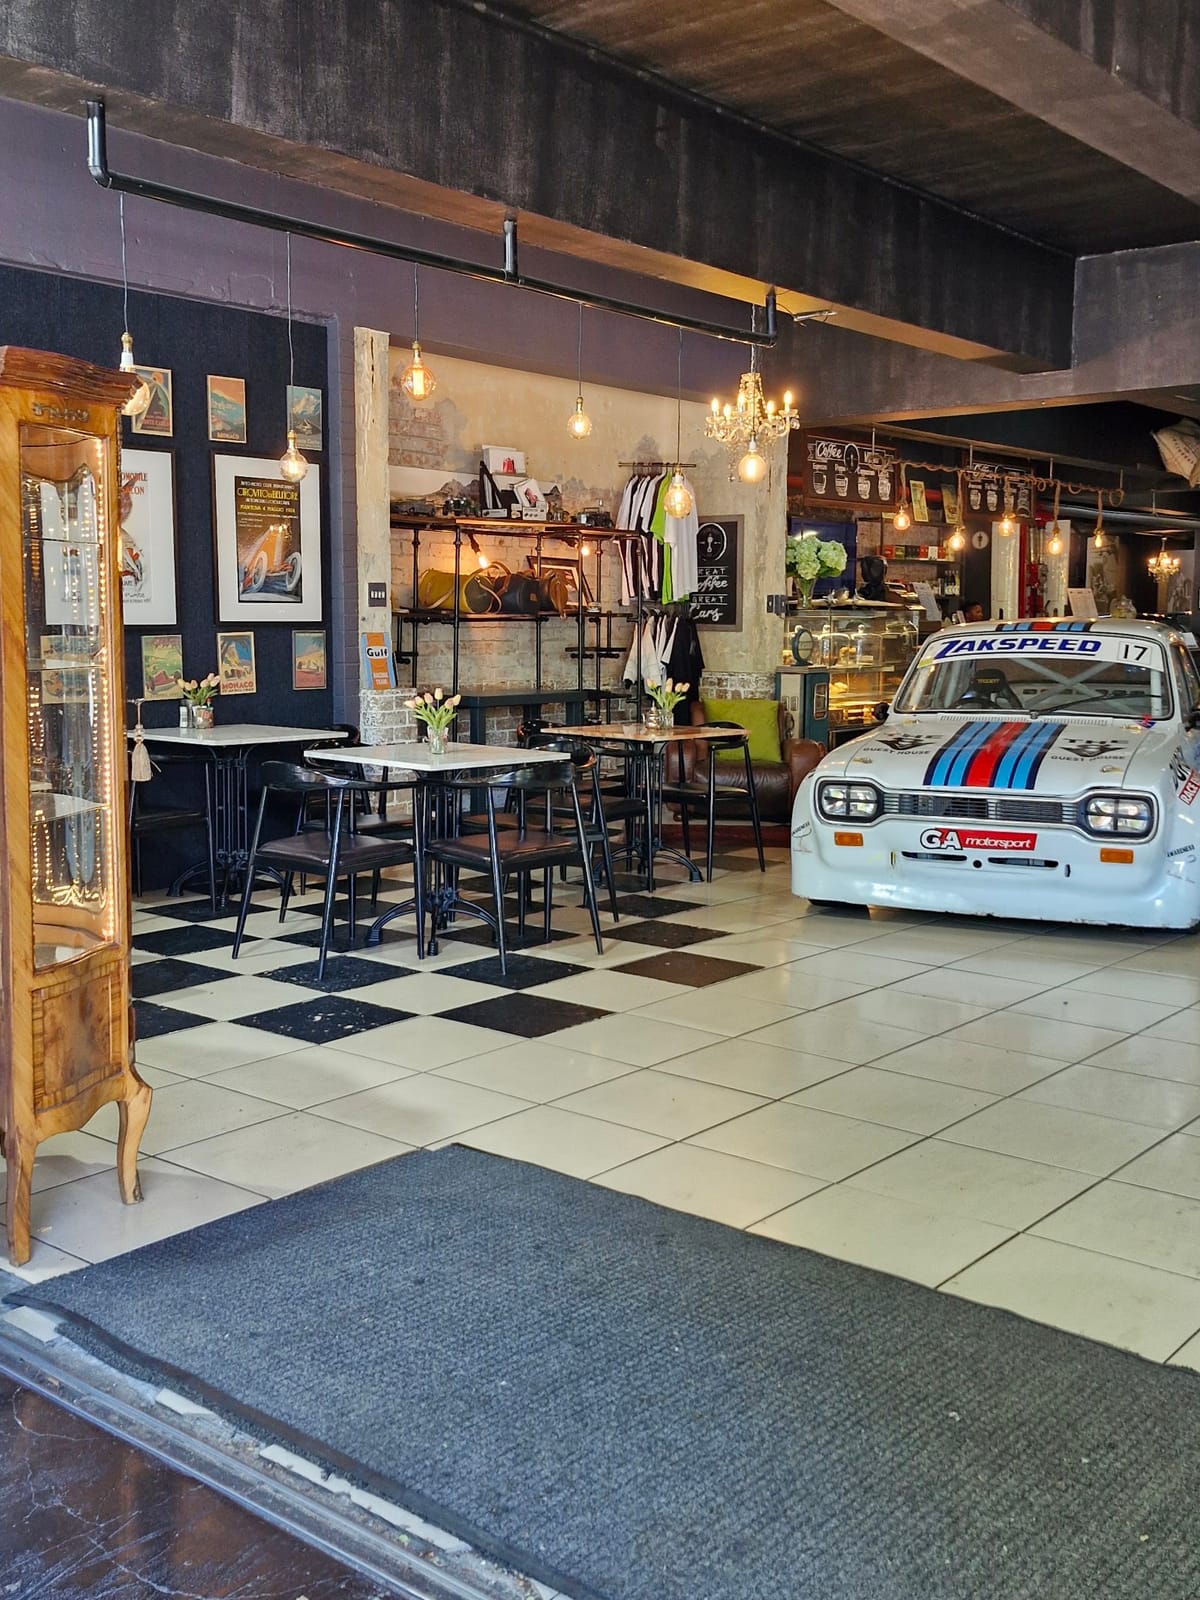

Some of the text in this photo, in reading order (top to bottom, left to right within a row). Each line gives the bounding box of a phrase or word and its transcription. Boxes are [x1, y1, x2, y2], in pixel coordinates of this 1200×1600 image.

[817, 442, 842, 459] Coffee
[698, 568, 726, 576] REAT
[697, 575, 728, 592] offee
[366, 647, 388, 657] Gulf
[934, 638, 1102, 659] ZAKSPEED
[1124, 644, 1149, 661] 17
[222, 681, 254, 690] MONACO
[920, 828, 1031, 850] GA motorsport
